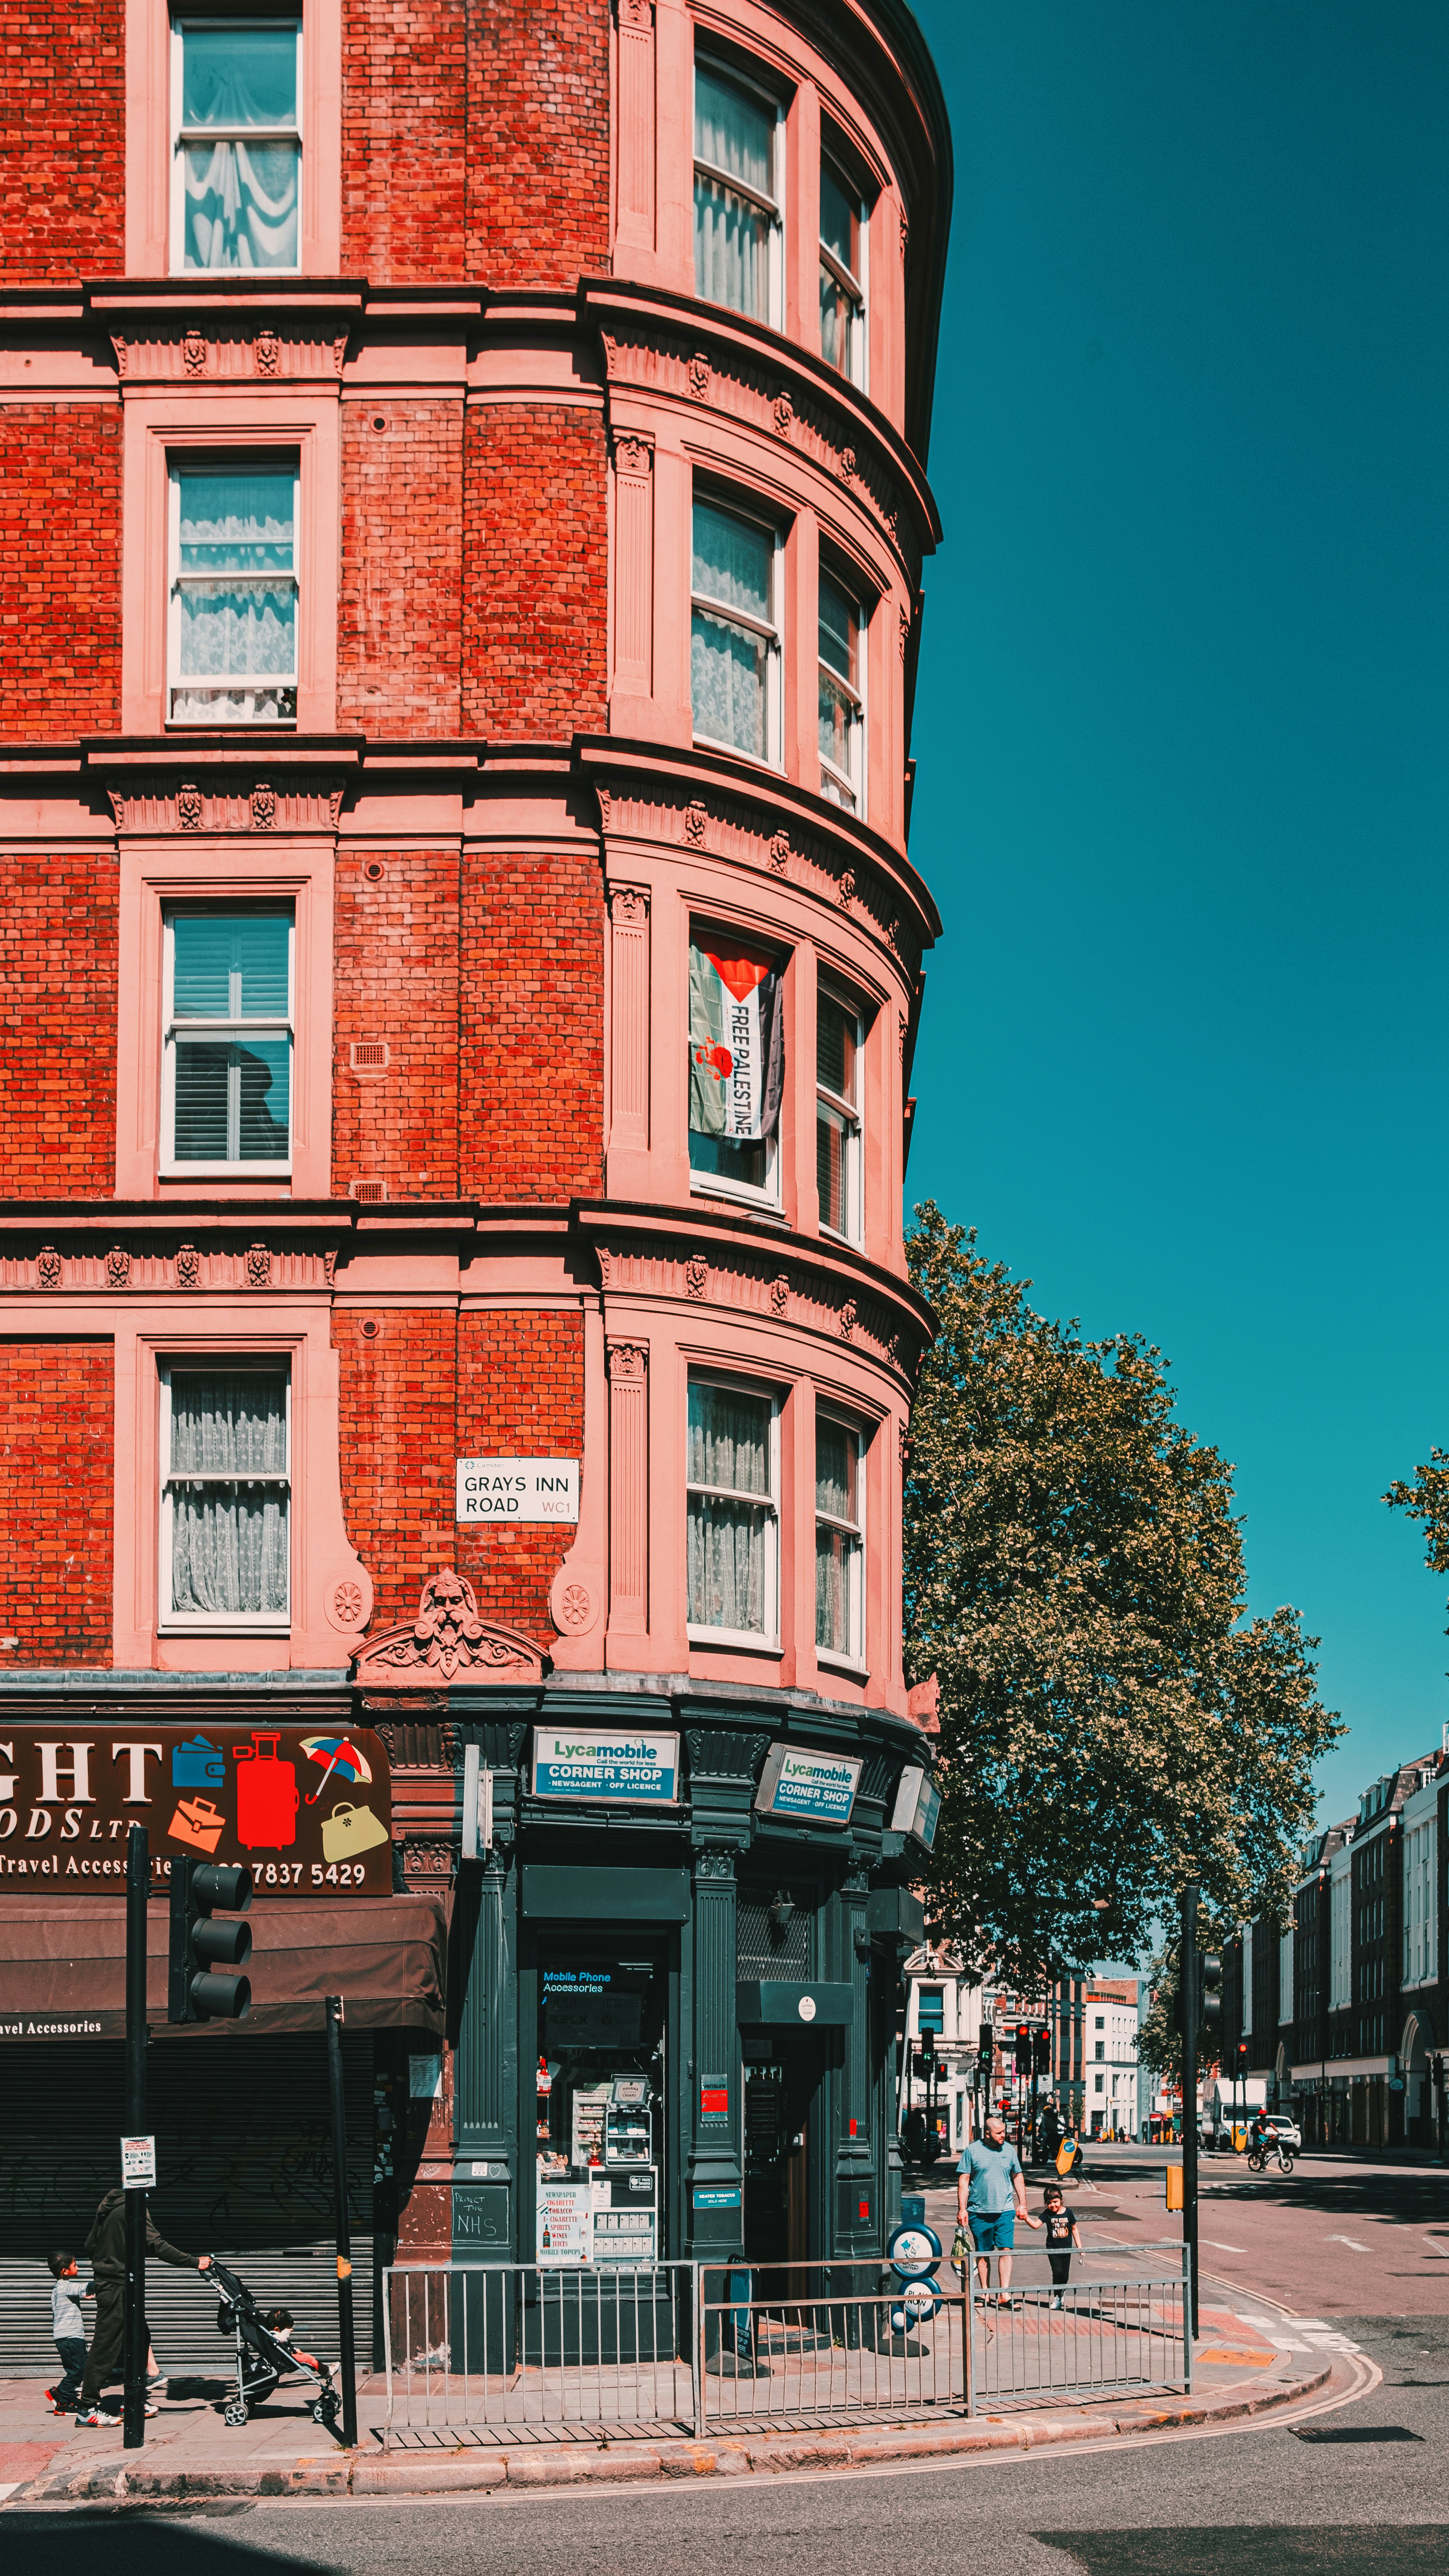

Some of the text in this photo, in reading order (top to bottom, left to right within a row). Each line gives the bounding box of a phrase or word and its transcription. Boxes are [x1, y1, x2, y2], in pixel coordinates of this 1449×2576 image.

[732, 1005, 752, 1135] FREE PALESTINE
[465, 1477, 568, 1492] GRAYS INN
[467, 1498, 570, 1513] ROAD WC1
[555, 1739, 657, 1759] Lycamobile
[549, 1765, 663, 1781] CORNER SHOP
[785, 1759, 852, 1784] Lycamobile
[779, 1783, 850, 1803] CORNER SHOP
[779, 1795, 811, 1806] NEWSAGENT
[825, 1803, 846, 1812] LICENCE
[66, 1855, 171, 1874] Accessie
[252, 1863, 302, 1884] 7837
[312, 1864, 365, 1884] 5429
[544, 1972, 610, 1982] Mobile Phone
[543, 1983, 603, 1993] Accessories
[27, 2020, 101, 2034] Accessories
[548, 2016, 587, 2024] RELX
[458, 2215, 496, 2236] NHS
[737, 2327, 750, 2338] OYSTER
[738, 2343, 746, 2352] HERE
